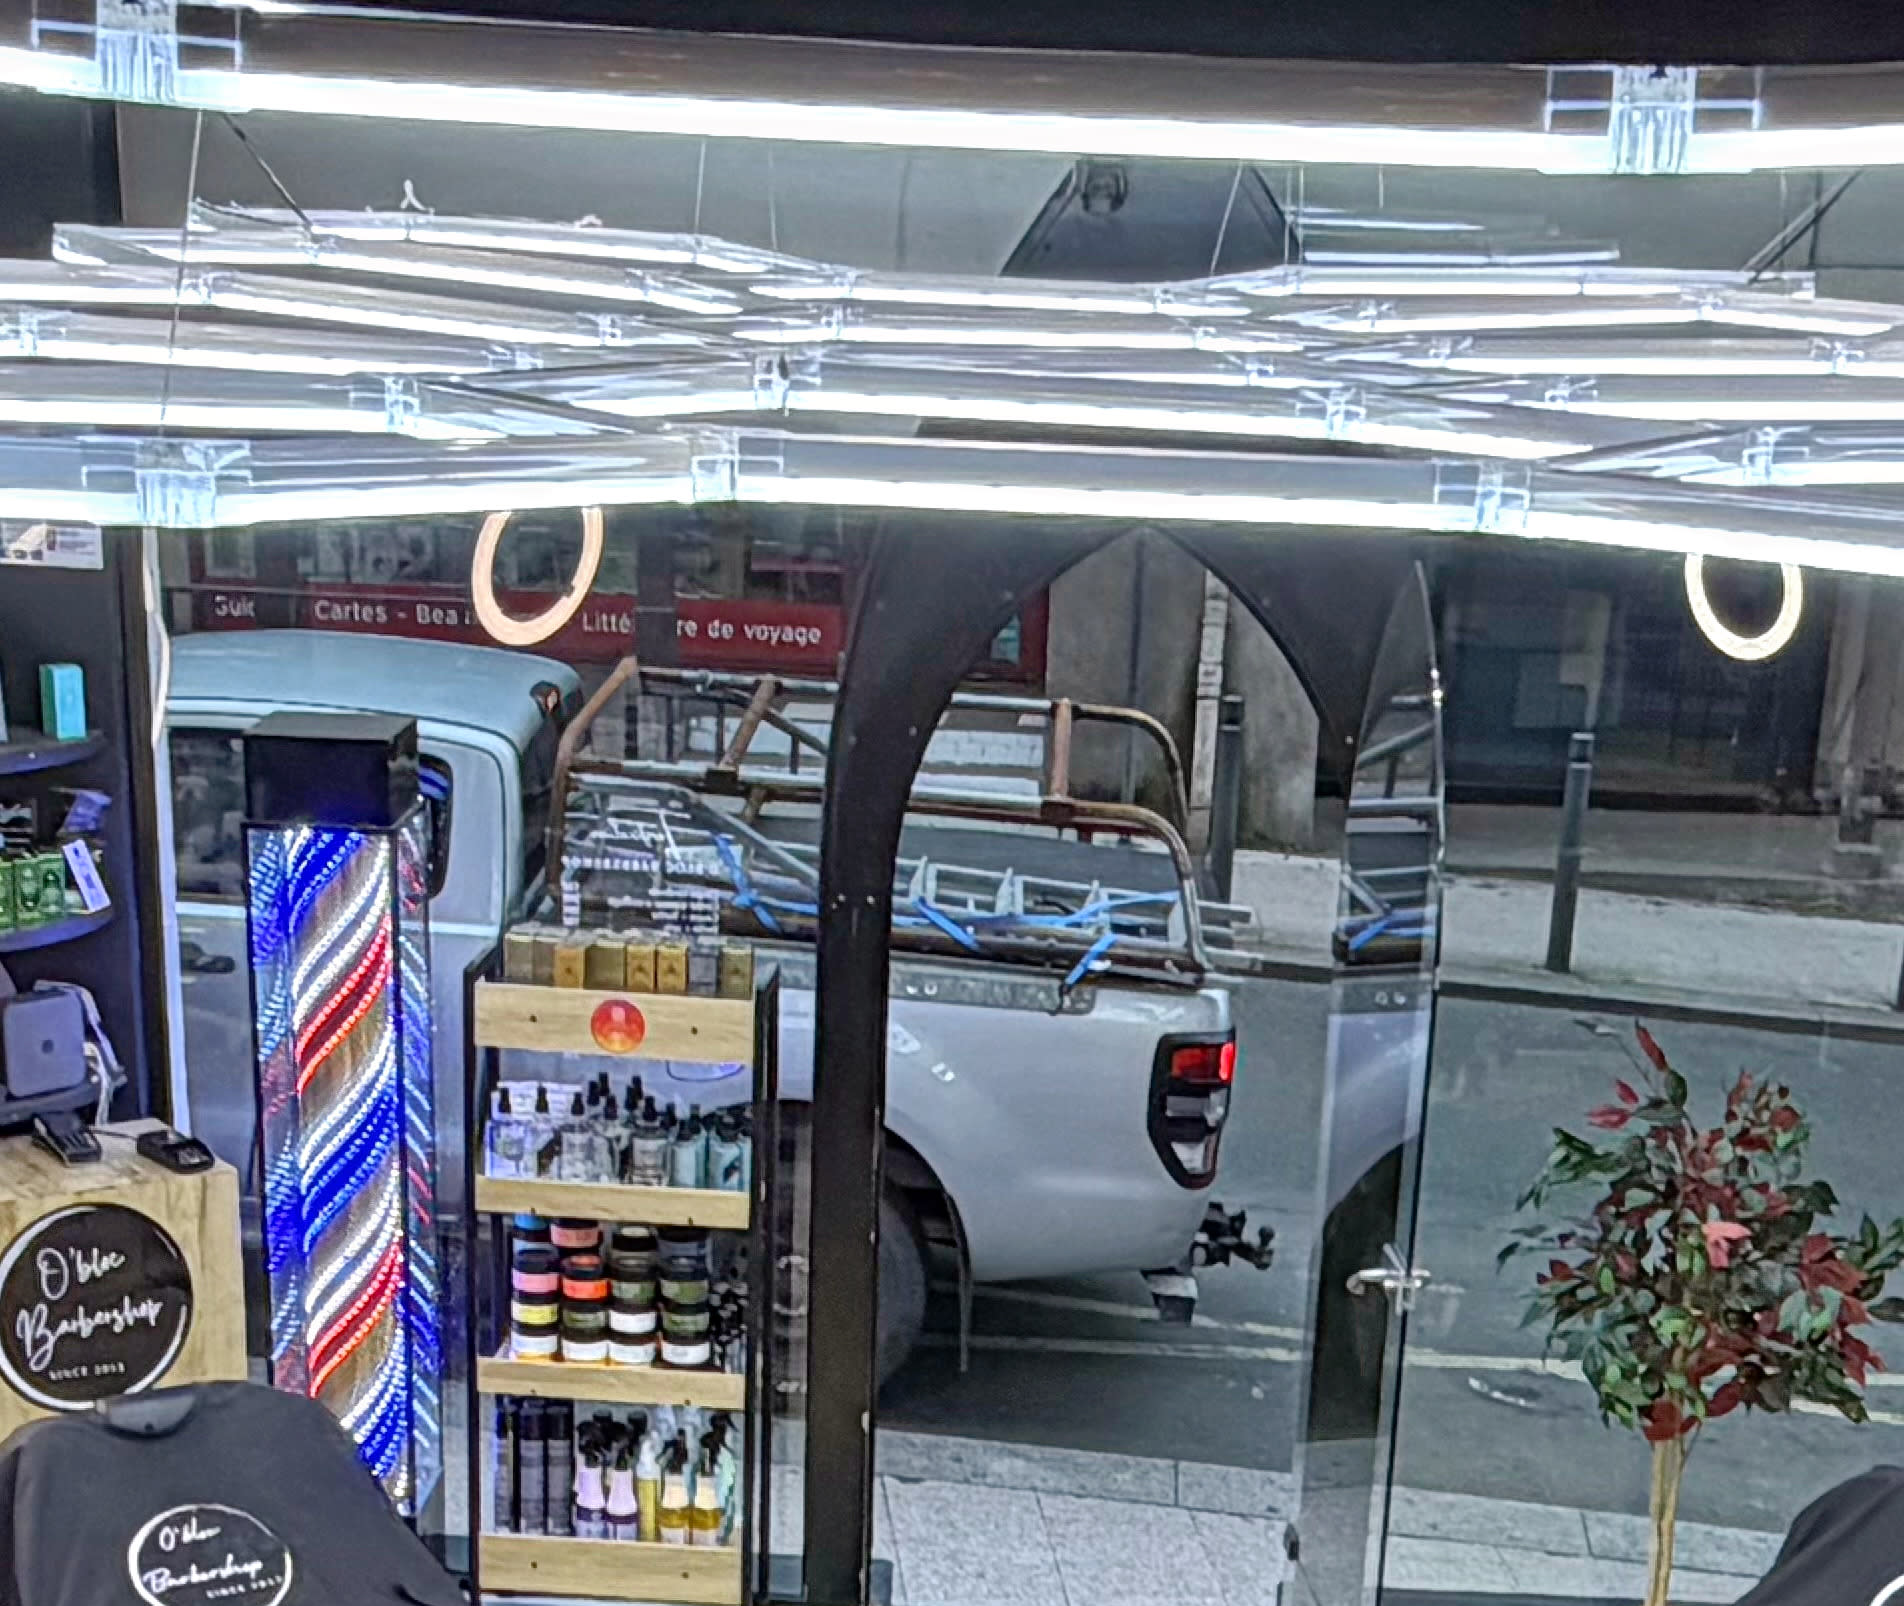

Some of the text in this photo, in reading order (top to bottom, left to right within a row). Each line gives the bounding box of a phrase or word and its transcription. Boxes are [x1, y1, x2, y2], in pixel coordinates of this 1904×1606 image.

[313, 599, 389, 622] Cartes
[707, 618, 734, 640] de
[744, 622, 823, 648] voyage
[15, 1295, 164, 1372] Barbershop
[142, 1553, 264, 1594] Barbershop
